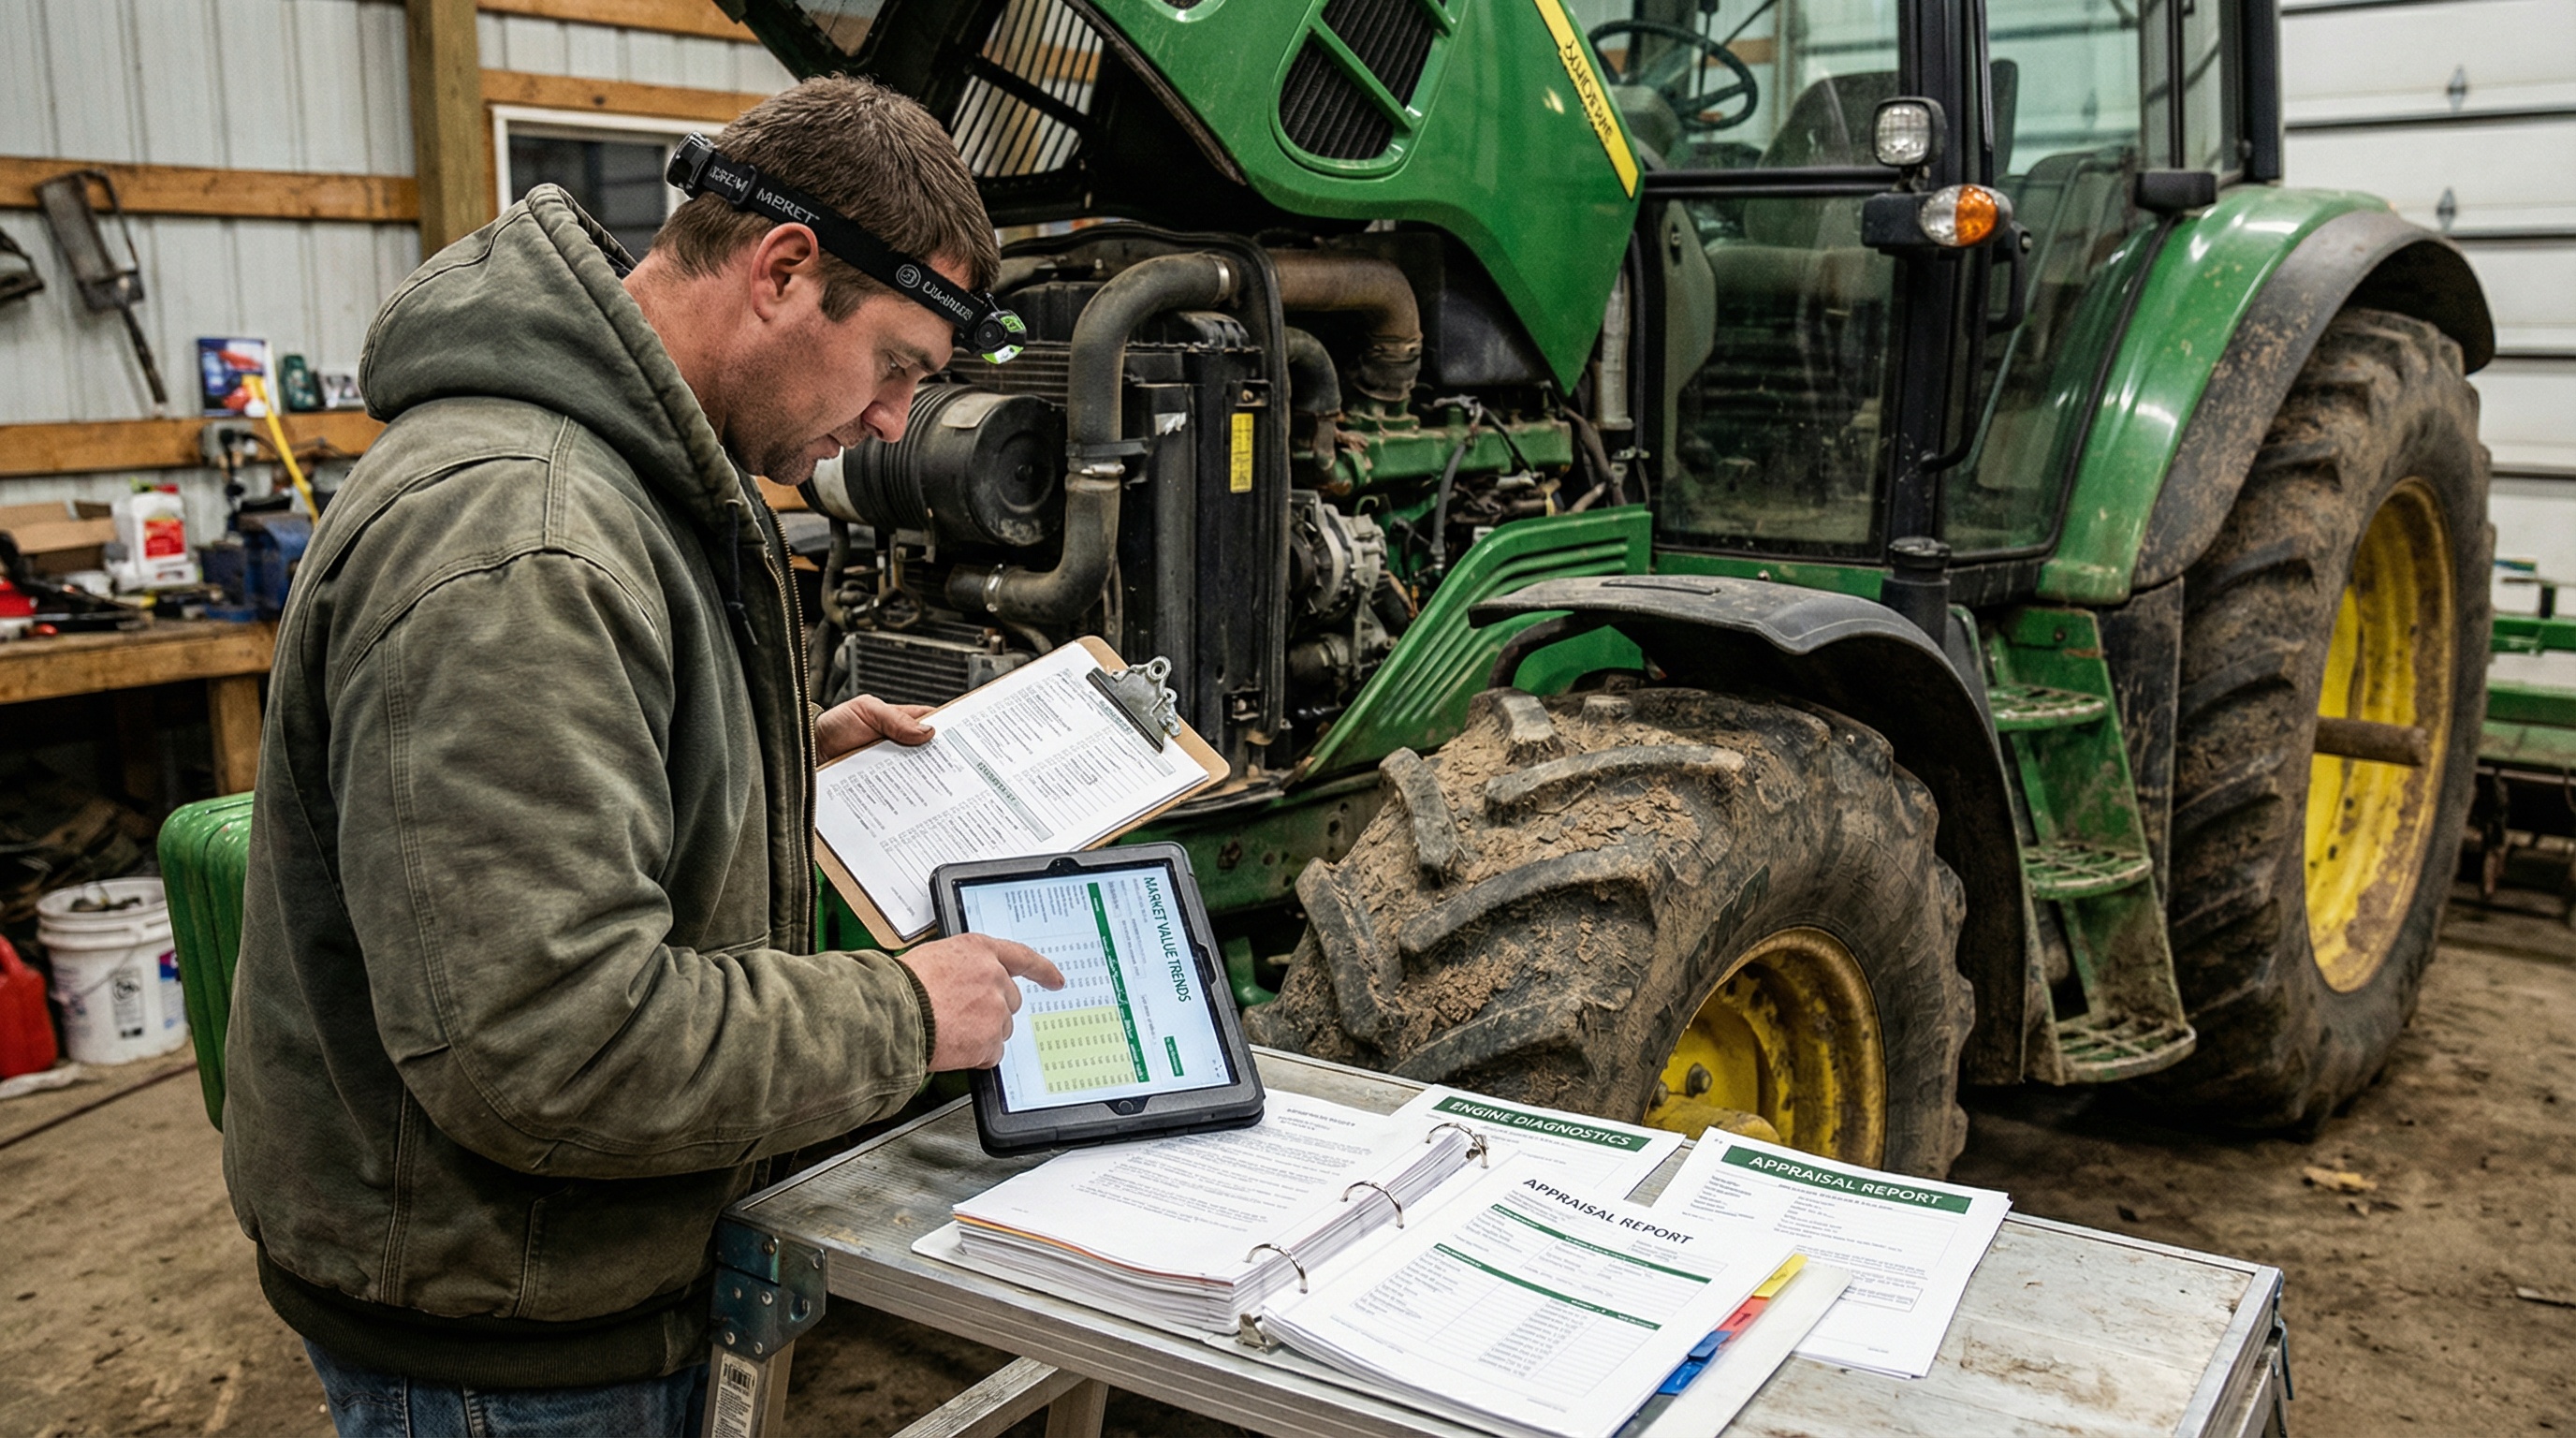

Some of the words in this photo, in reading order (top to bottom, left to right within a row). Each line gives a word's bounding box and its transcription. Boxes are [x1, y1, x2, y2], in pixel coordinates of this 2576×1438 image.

[1144, 877, 1168, 920] MARKET
[1157, 921, 1178, 959] VALUE
[1168, 958, 1192, 1003] TRENDS
[1449, 1101, 1515, 1123] ENGINE
[1513, 1115, 1632, 1147] DIAGNOSTICS
[1749, 1155, 1856, 1191] APPRAISAL
[1861, 1182, 1943, 1206] REPORT
[1523, 1178, 1615, 1223] APPRAISAL
[1619, 1217, 1694, 1245] REPORT
